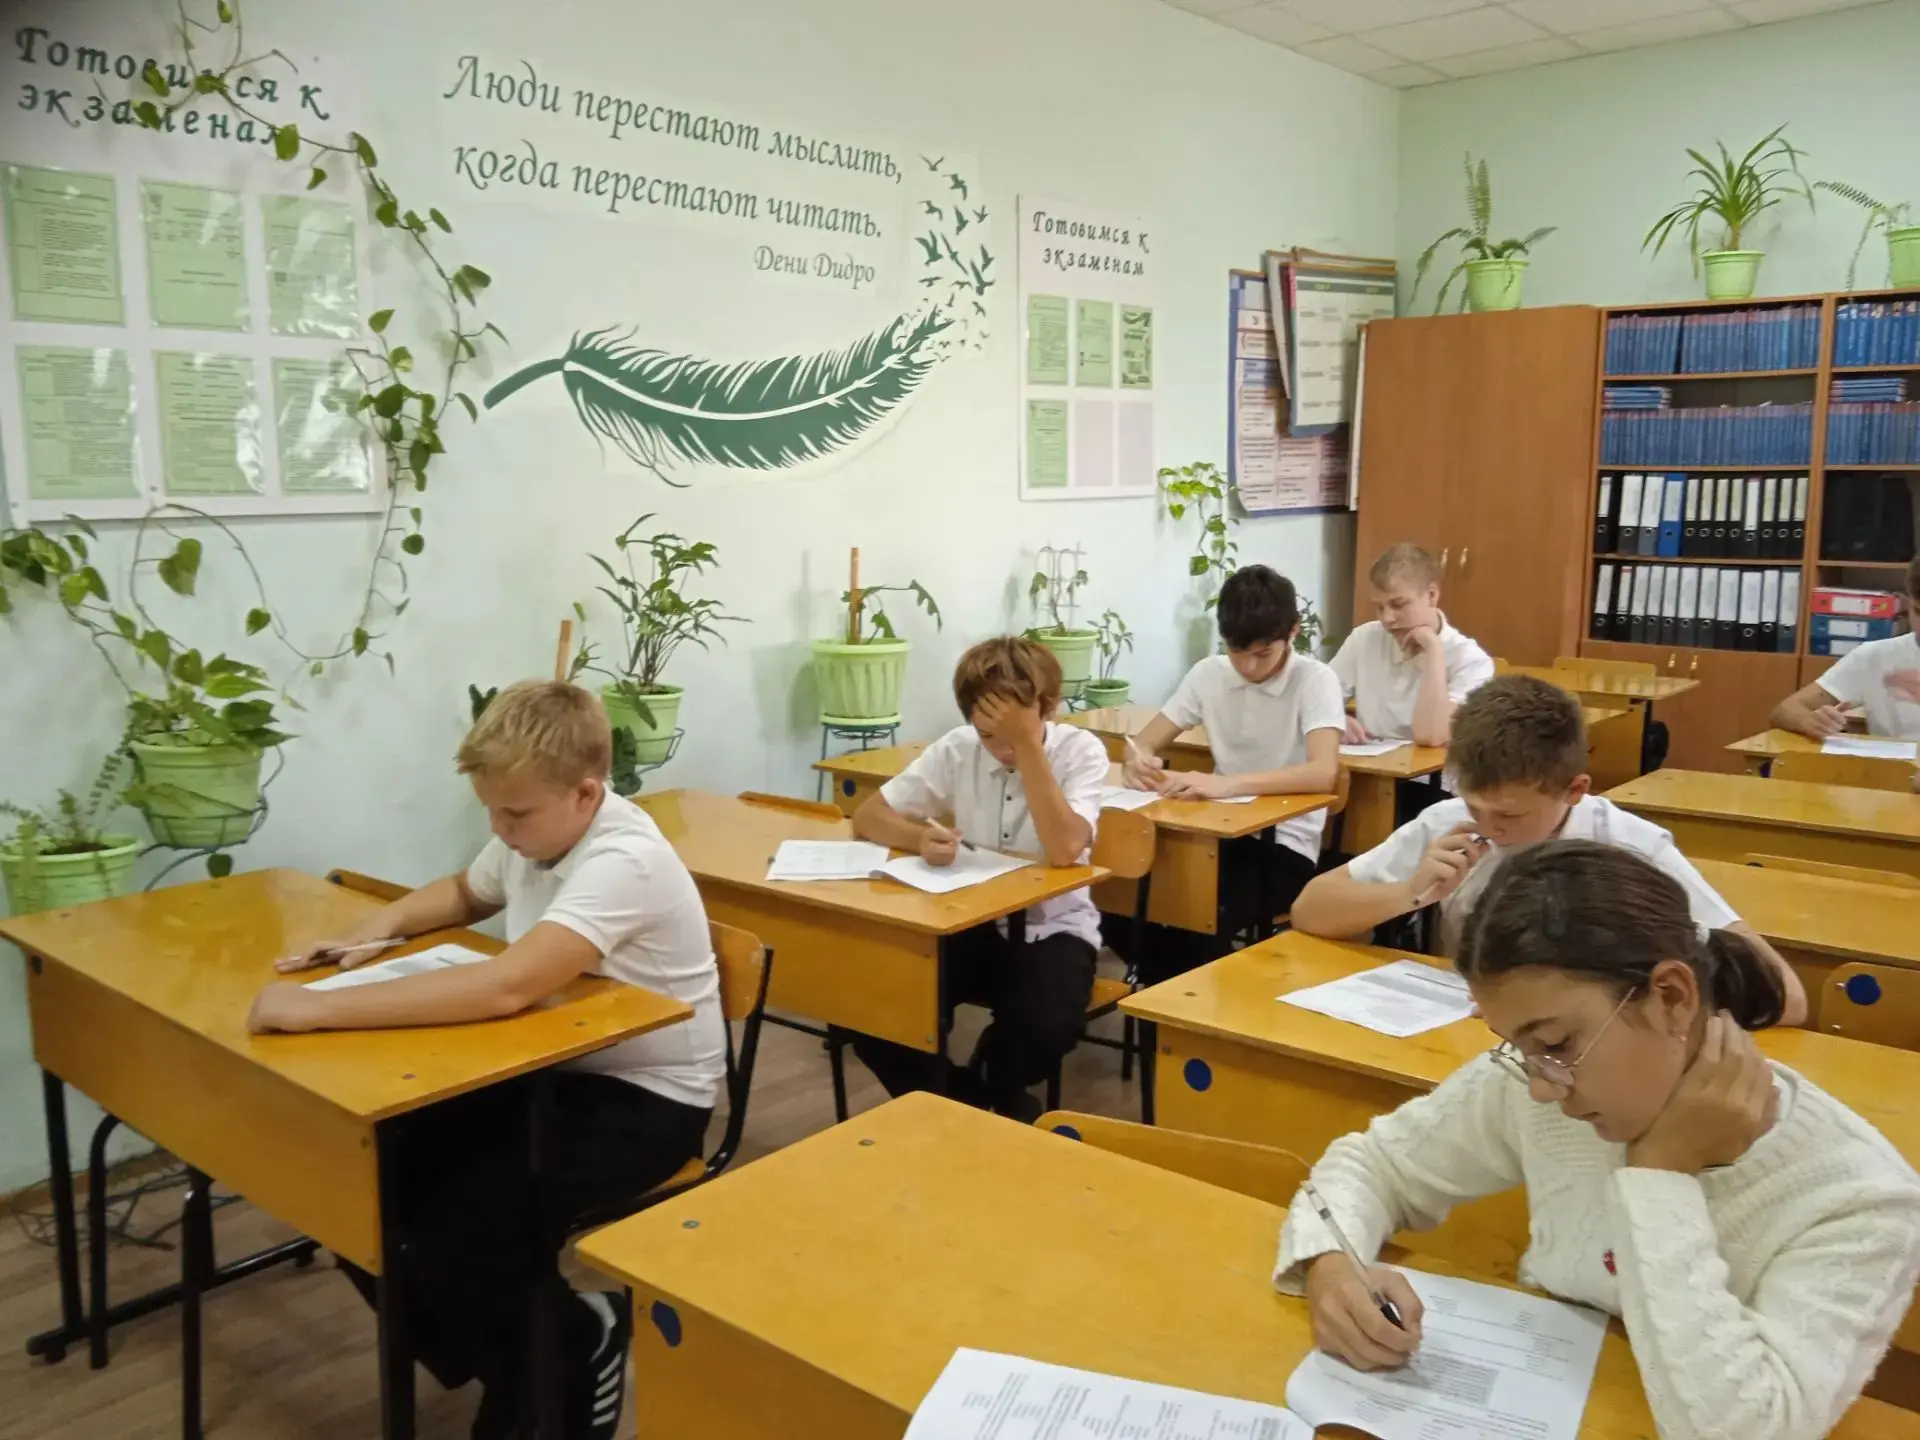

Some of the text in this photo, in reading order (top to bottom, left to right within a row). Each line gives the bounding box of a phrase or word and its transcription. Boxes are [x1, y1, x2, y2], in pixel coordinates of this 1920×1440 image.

[15, 27, 330, 121] Готоися к
[18, 84, 281, 146] экзаена
[443, 55, 903, 184] Люди перестают мыслить,
[454, 138, 883, 239] когда перестают читать.
[1033, 211, 1150, 254] Готовимся к
[1043, 247, 1145, 276] экзаменам
[754, 245, 876, 290] Дени Дидро
